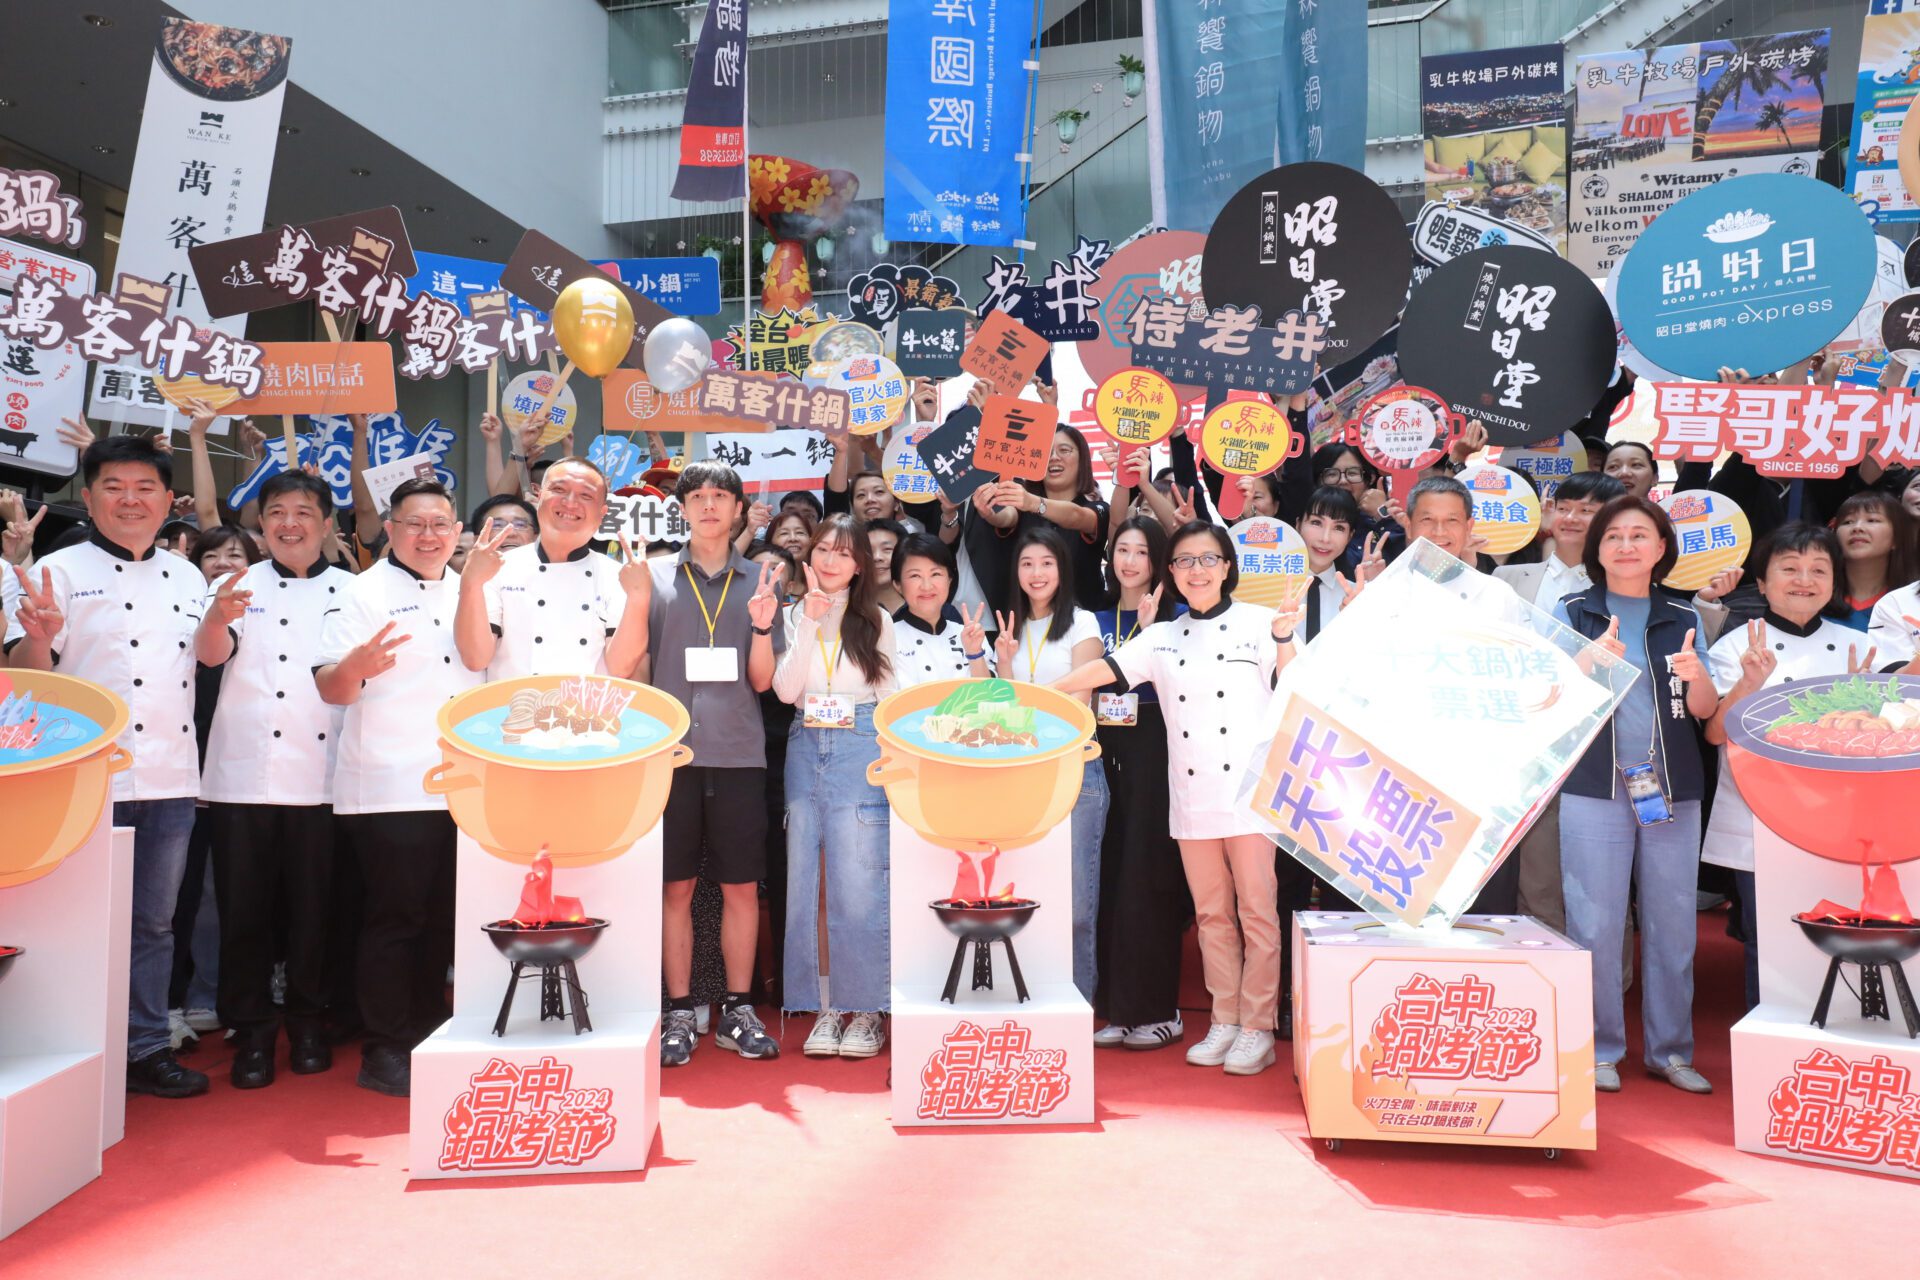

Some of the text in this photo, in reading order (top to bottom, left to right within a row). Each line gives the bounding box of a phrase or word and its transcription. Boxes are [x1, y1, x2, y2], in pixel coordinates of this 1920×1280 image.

[187, 128, 212, 138] WAN
[1620, 107, 1692, 138] LOVE
[1653, 172, 1725, 187] Witamy
[1618, 189, 1674, 203] SHALOM
[1568, 219, 1639, 234] Welkom
[1283, 195, 1347, 328] 昭日堂
[263, 227, 459, 358] 萬客什鍋
[621, 272, 682, 296] 小鍋
[1662, 295, 1695, 305] GOOD
[1703, 289, 1725, 299] POT
[1732, 284, 1757, 294] DAY
[0, 276, 263, 395] 萬客什鍋
[401, 310, 564, 378] 萬客什
[1042, 326, 1093, 336] YAKINIKU
[1127, 297, 1327, 363] 侍老井
[1491, 283, 1557, 409] 昭日堂
[970, 356, 1016, 390] AKUAN
[1134, 353, 1310, 378] SAMURAI YAKINIKU
[703, 372, 846, 431] 萬客什鍋
[851, 404, 887, 425] 專家
[1451, 403, 1531, 432] SHOU NICHI DOU
[983, 438, 1043, 459] 阿官火鍋
[983, 451, 1039, 470] AKUAN
[1762, 461, 1839, 474] SINCE 1956
[1677, 523, 1737, 556] 屋馬
[1235, 553, 1305, 574] 馬崇德
[1396, 974, 1495, 1026] 台中
[1486, 1009, 1536, 1028] 2024
[944, 1020, 1031, 1070] 台中
[1022, 1050, 1066, 1068] 2024
[1372, 1025, 1540, 1081] 鍋烤節
[470, 1056, 573, 1112] 台中
[1795, 1048, 1911, 1108] 台中
[562, 1088, 612, 1109] 2024
[917, 1068, 1071, 1120] 鍋烤節
[1364, 1097, 1411, 1110] 火力全開
[438, 1109, 617, 1171] 鍋烤節
